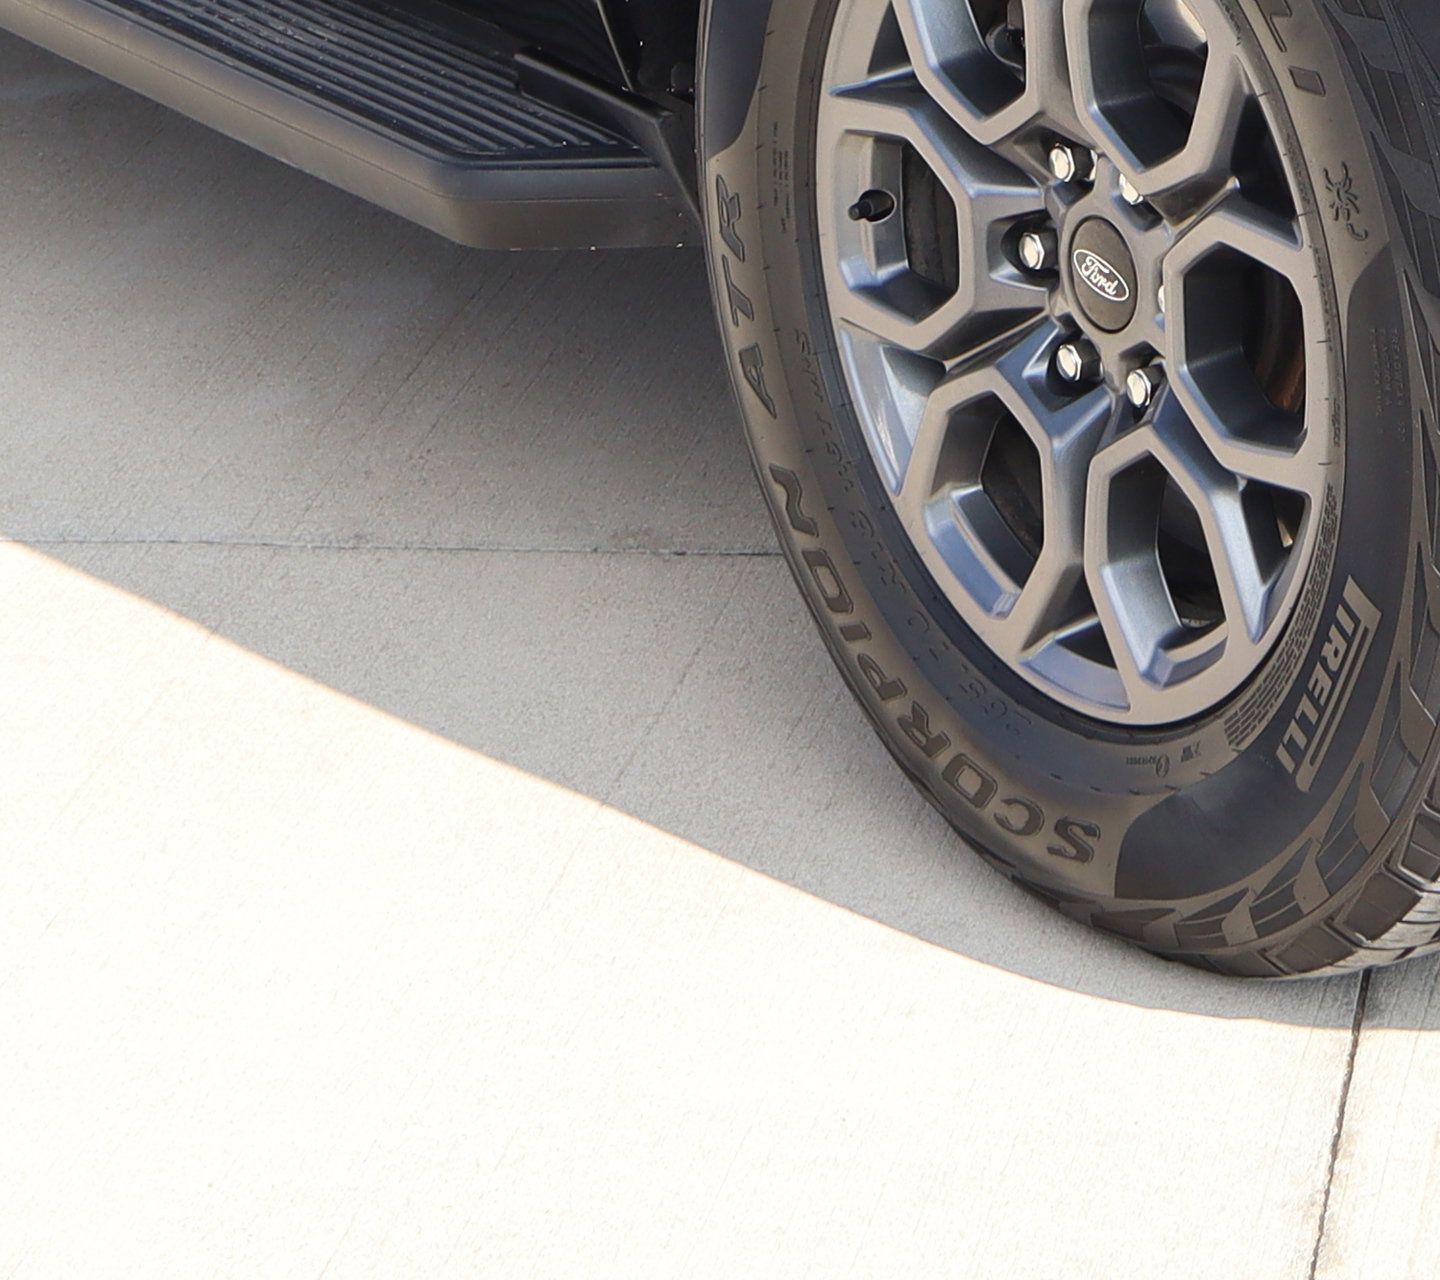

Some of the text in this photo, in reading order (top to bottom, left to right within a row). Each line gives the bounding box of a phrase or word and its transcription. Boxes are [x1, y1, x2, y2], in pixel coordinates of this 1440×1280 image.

[1081, 255, 1119, 296] Ford
[716, 174, 1101, 864] SCORPION ATR
[1276, 574, 1383, 793] PIRELLI
